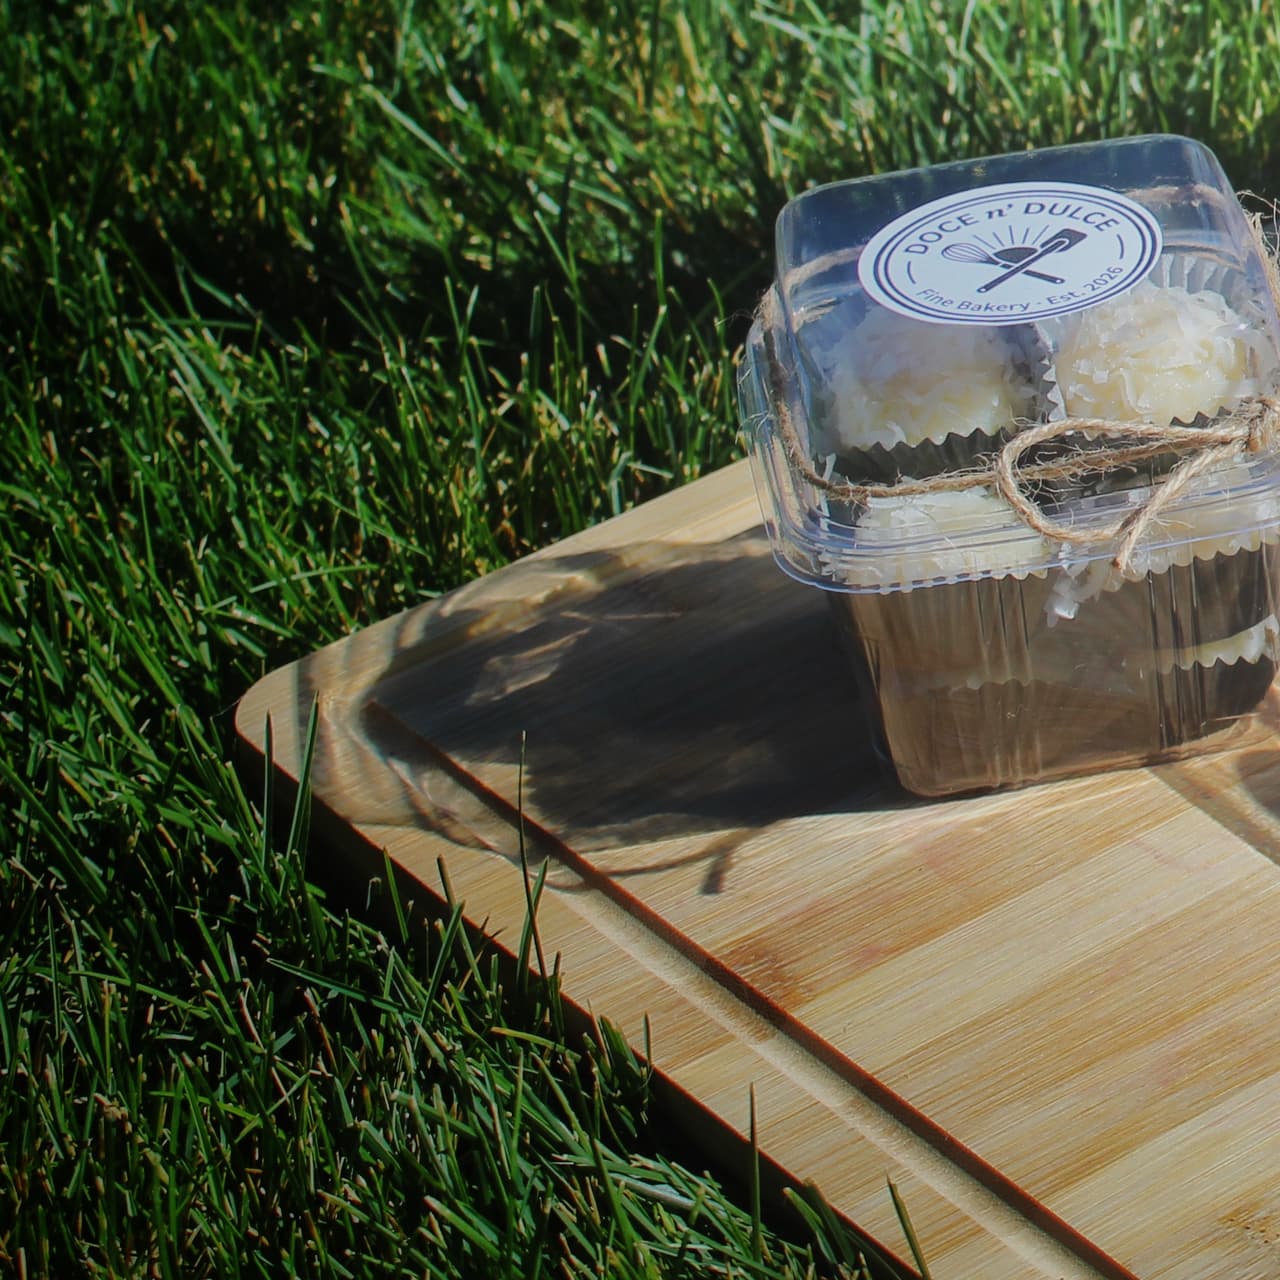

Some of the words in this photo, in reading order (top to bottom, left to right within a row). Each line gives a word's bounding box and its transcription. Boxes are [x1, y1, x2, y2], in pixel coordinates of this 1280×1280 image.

[905, 213, 979, 255] DOCE
[1024, 202, 1120, 232] DULCE
[917, 288, 954, 308] Fine
[957, 300, 1030, 313] Bakery
[1047, 291, 1082, 304] Est.
[1084, 266, 1123, 290] 2026
